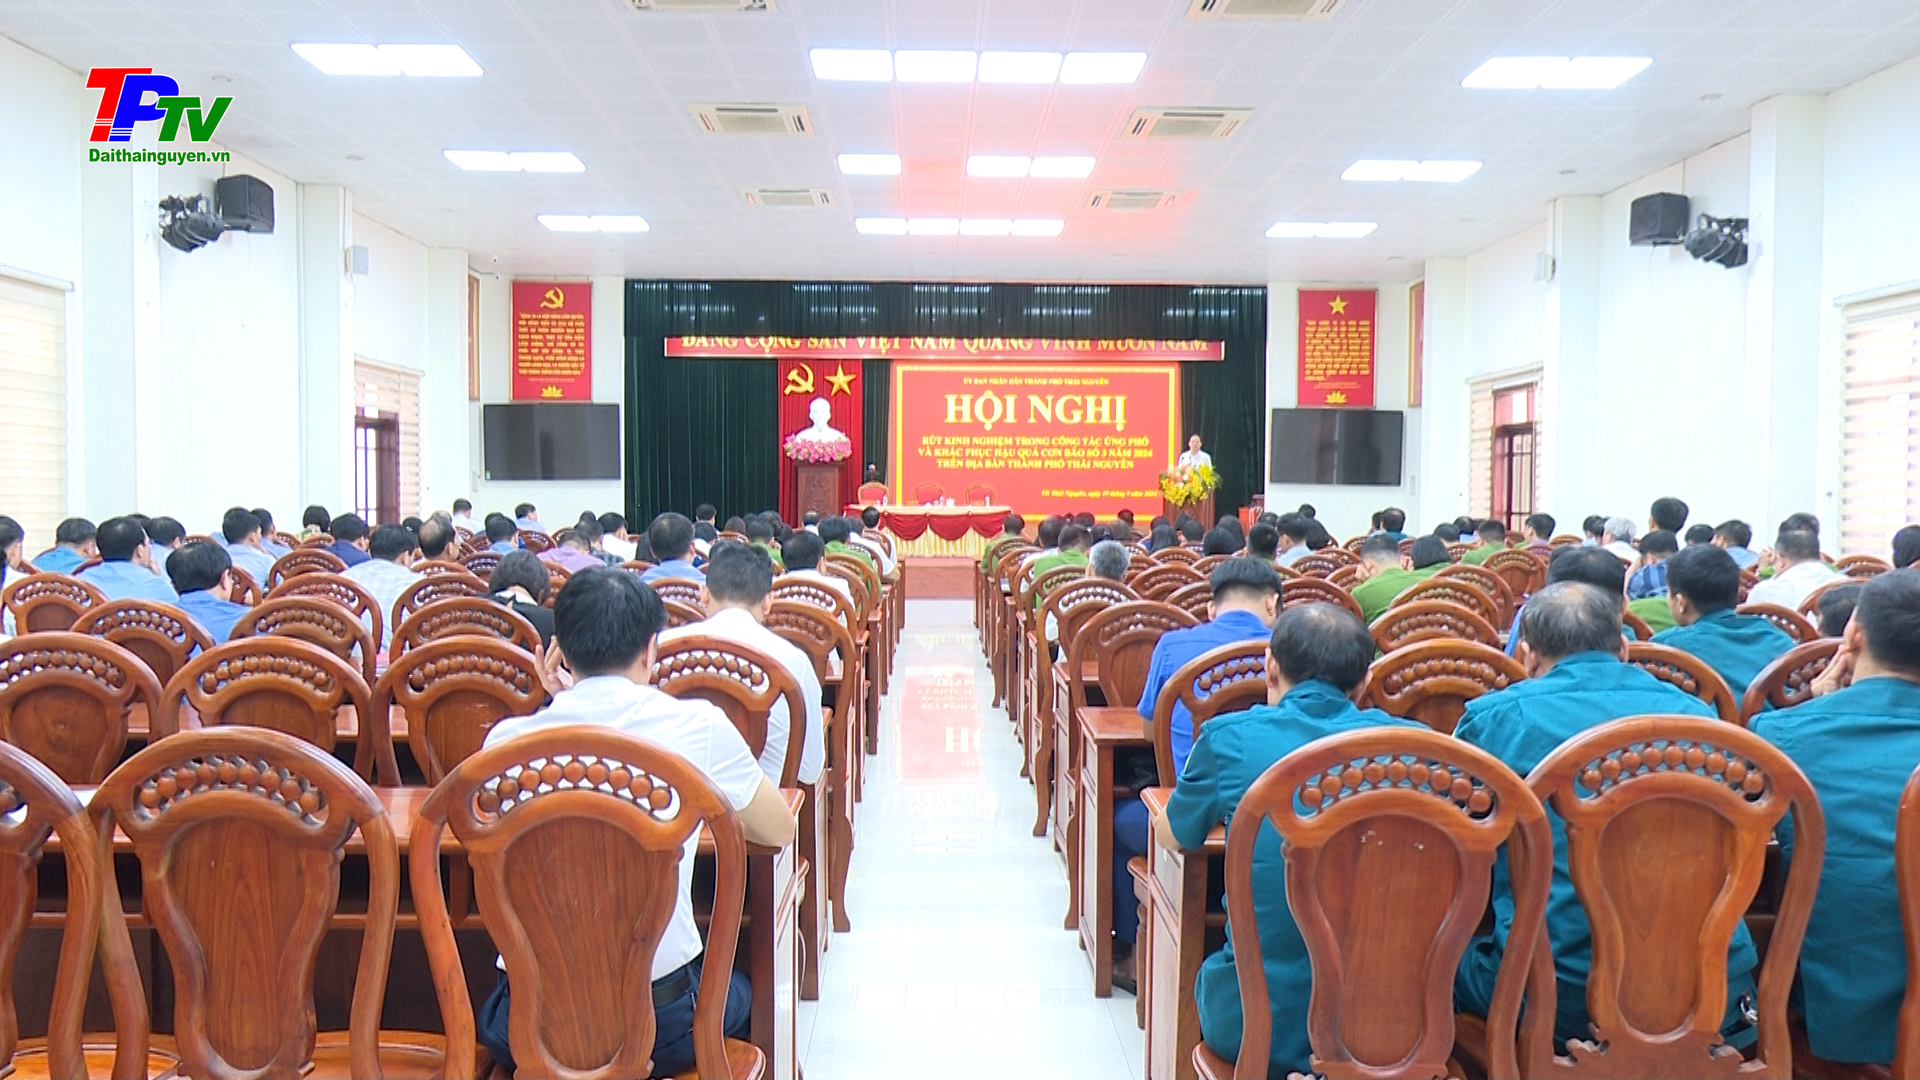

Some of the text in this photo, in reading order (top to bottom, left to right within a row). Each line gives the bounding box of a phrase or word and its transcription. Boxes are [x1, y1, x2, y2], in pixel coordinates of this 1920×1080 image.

[909, 337, 957, 349] NAM
[963, 338, 1033, 354] QUANG
[1041, 338, 1091, 351] VINH
[944, 390, 1127, 431] HỘI NGHỊ
[922, 435, 1149, 446] RÚT KINH NGHIỆM TRONG CÔNG TÁC ỨNG PHÓ
[918, 447, 1153, 459] VÀ KHÁC PHỤC HẬU QUẢ CƠN BÃO SỐ 3 NĂM 2024
[936, 458, 1134, 470] TRÊN ĐỊA BÀN THÀNH PHỐ THÁI NGUYÊN
